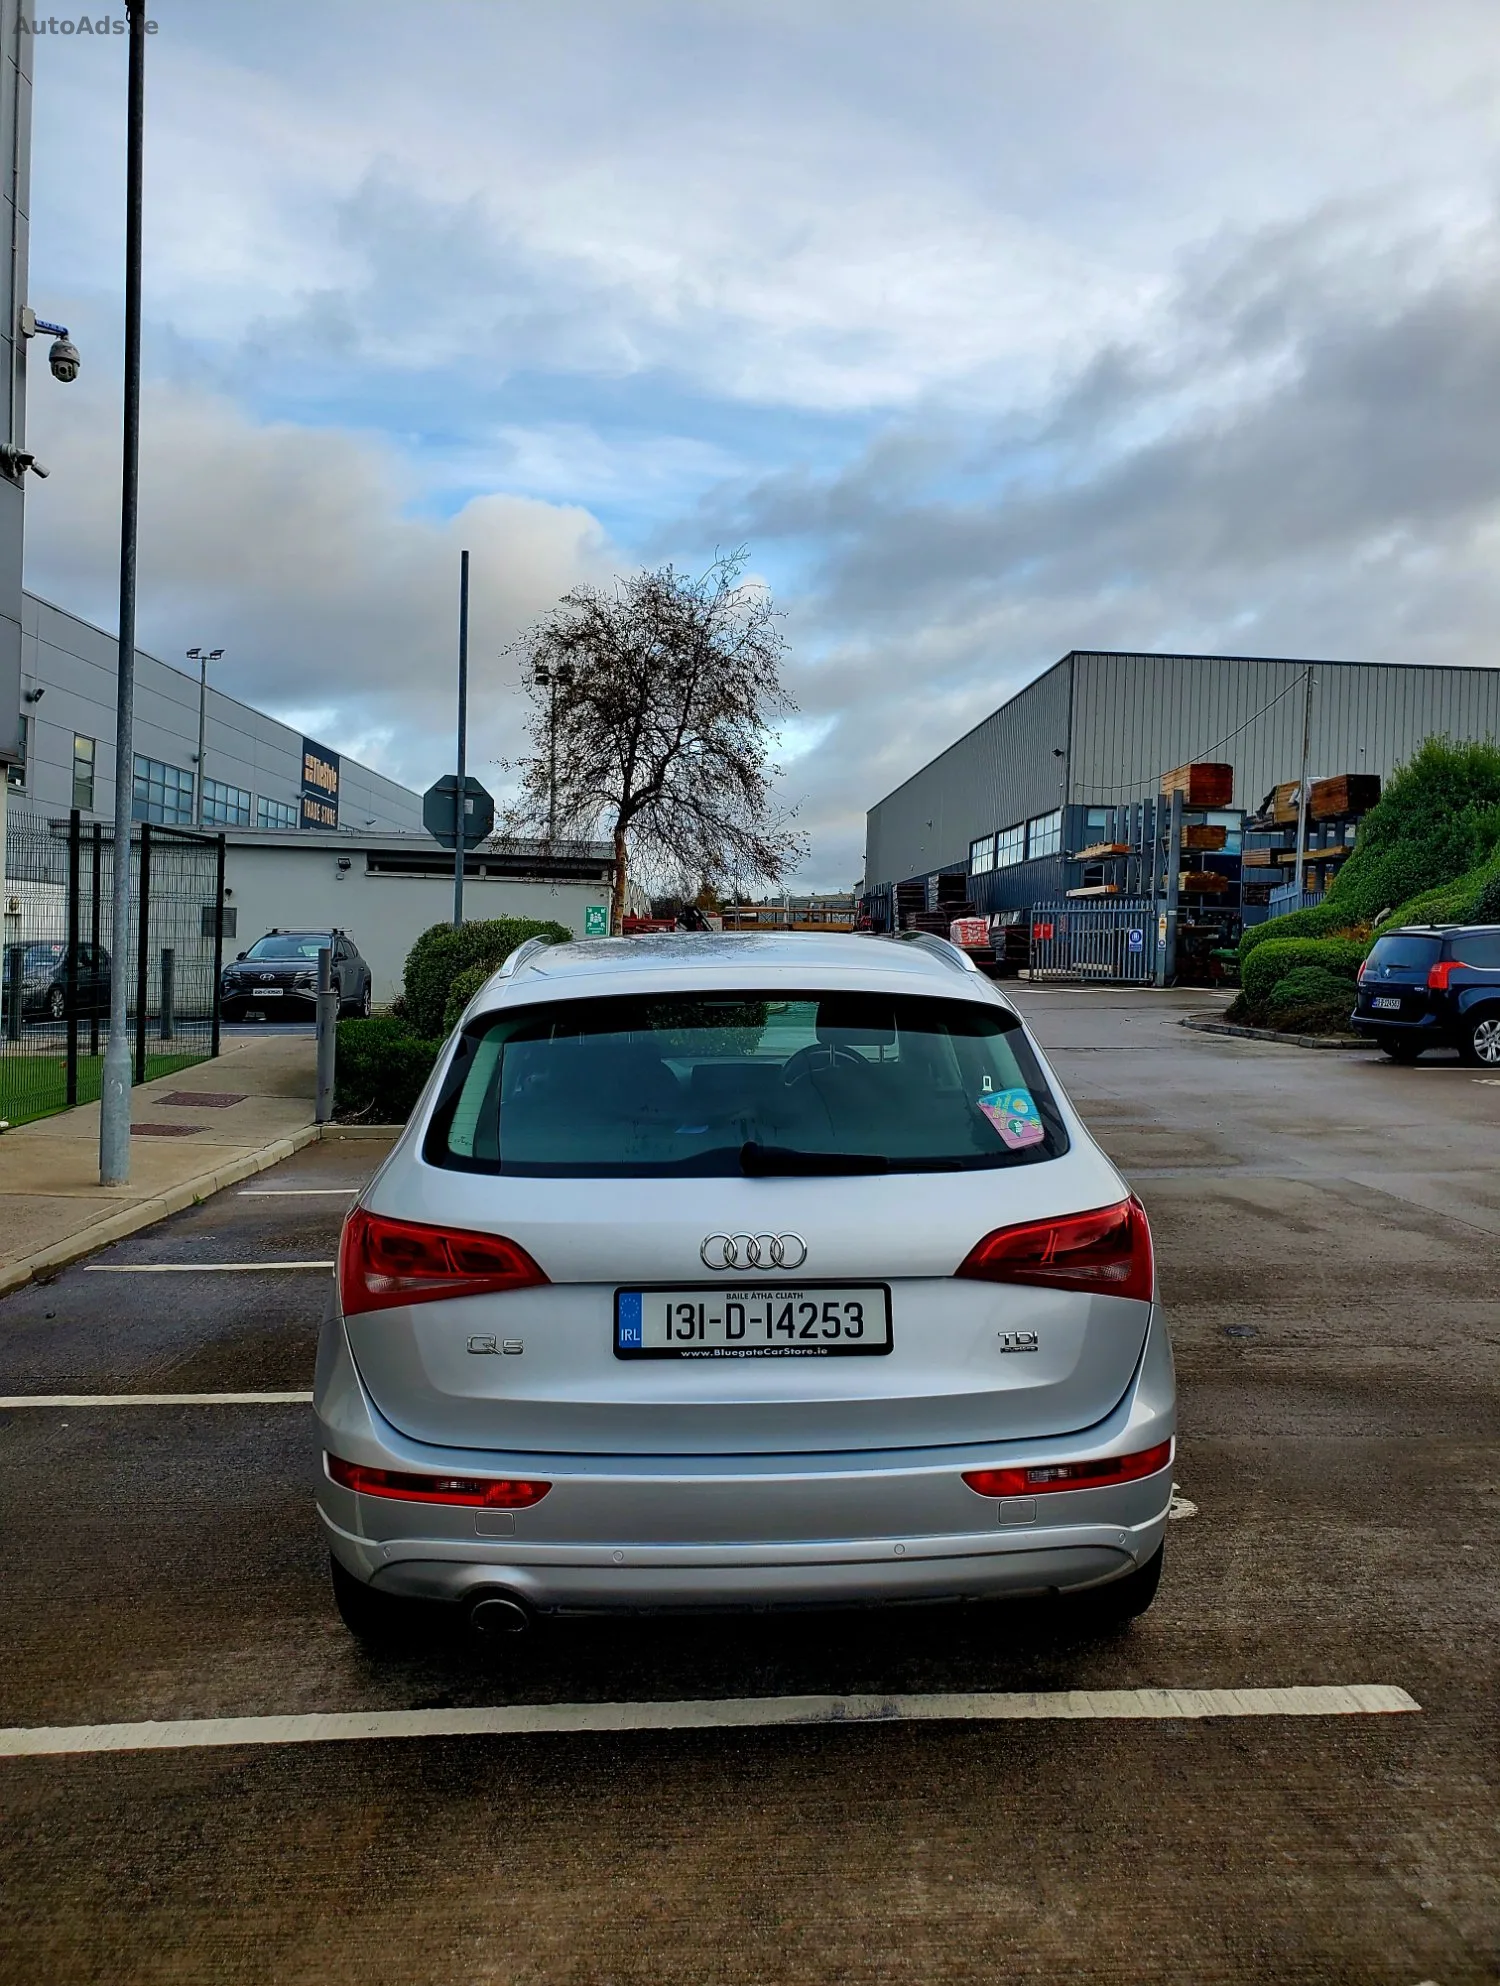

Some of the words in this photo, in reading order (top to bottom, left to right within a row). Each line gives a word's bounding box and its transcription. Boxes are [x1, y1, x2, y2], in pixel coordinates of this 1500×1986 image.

[726, 1292, 749, 1300] BAILE
[775, 1292, 804, 1300] CLIATH
[666, 1302, 864, 1340] 131-D-14253
[621, 1329, 640, 1341] IRL
[998, 1331, 1038, 1345] TDI
[467, 1332, 524, 1355] Q5
[681, 1347, 828, 1357] www.BluegateCarStore.ie
